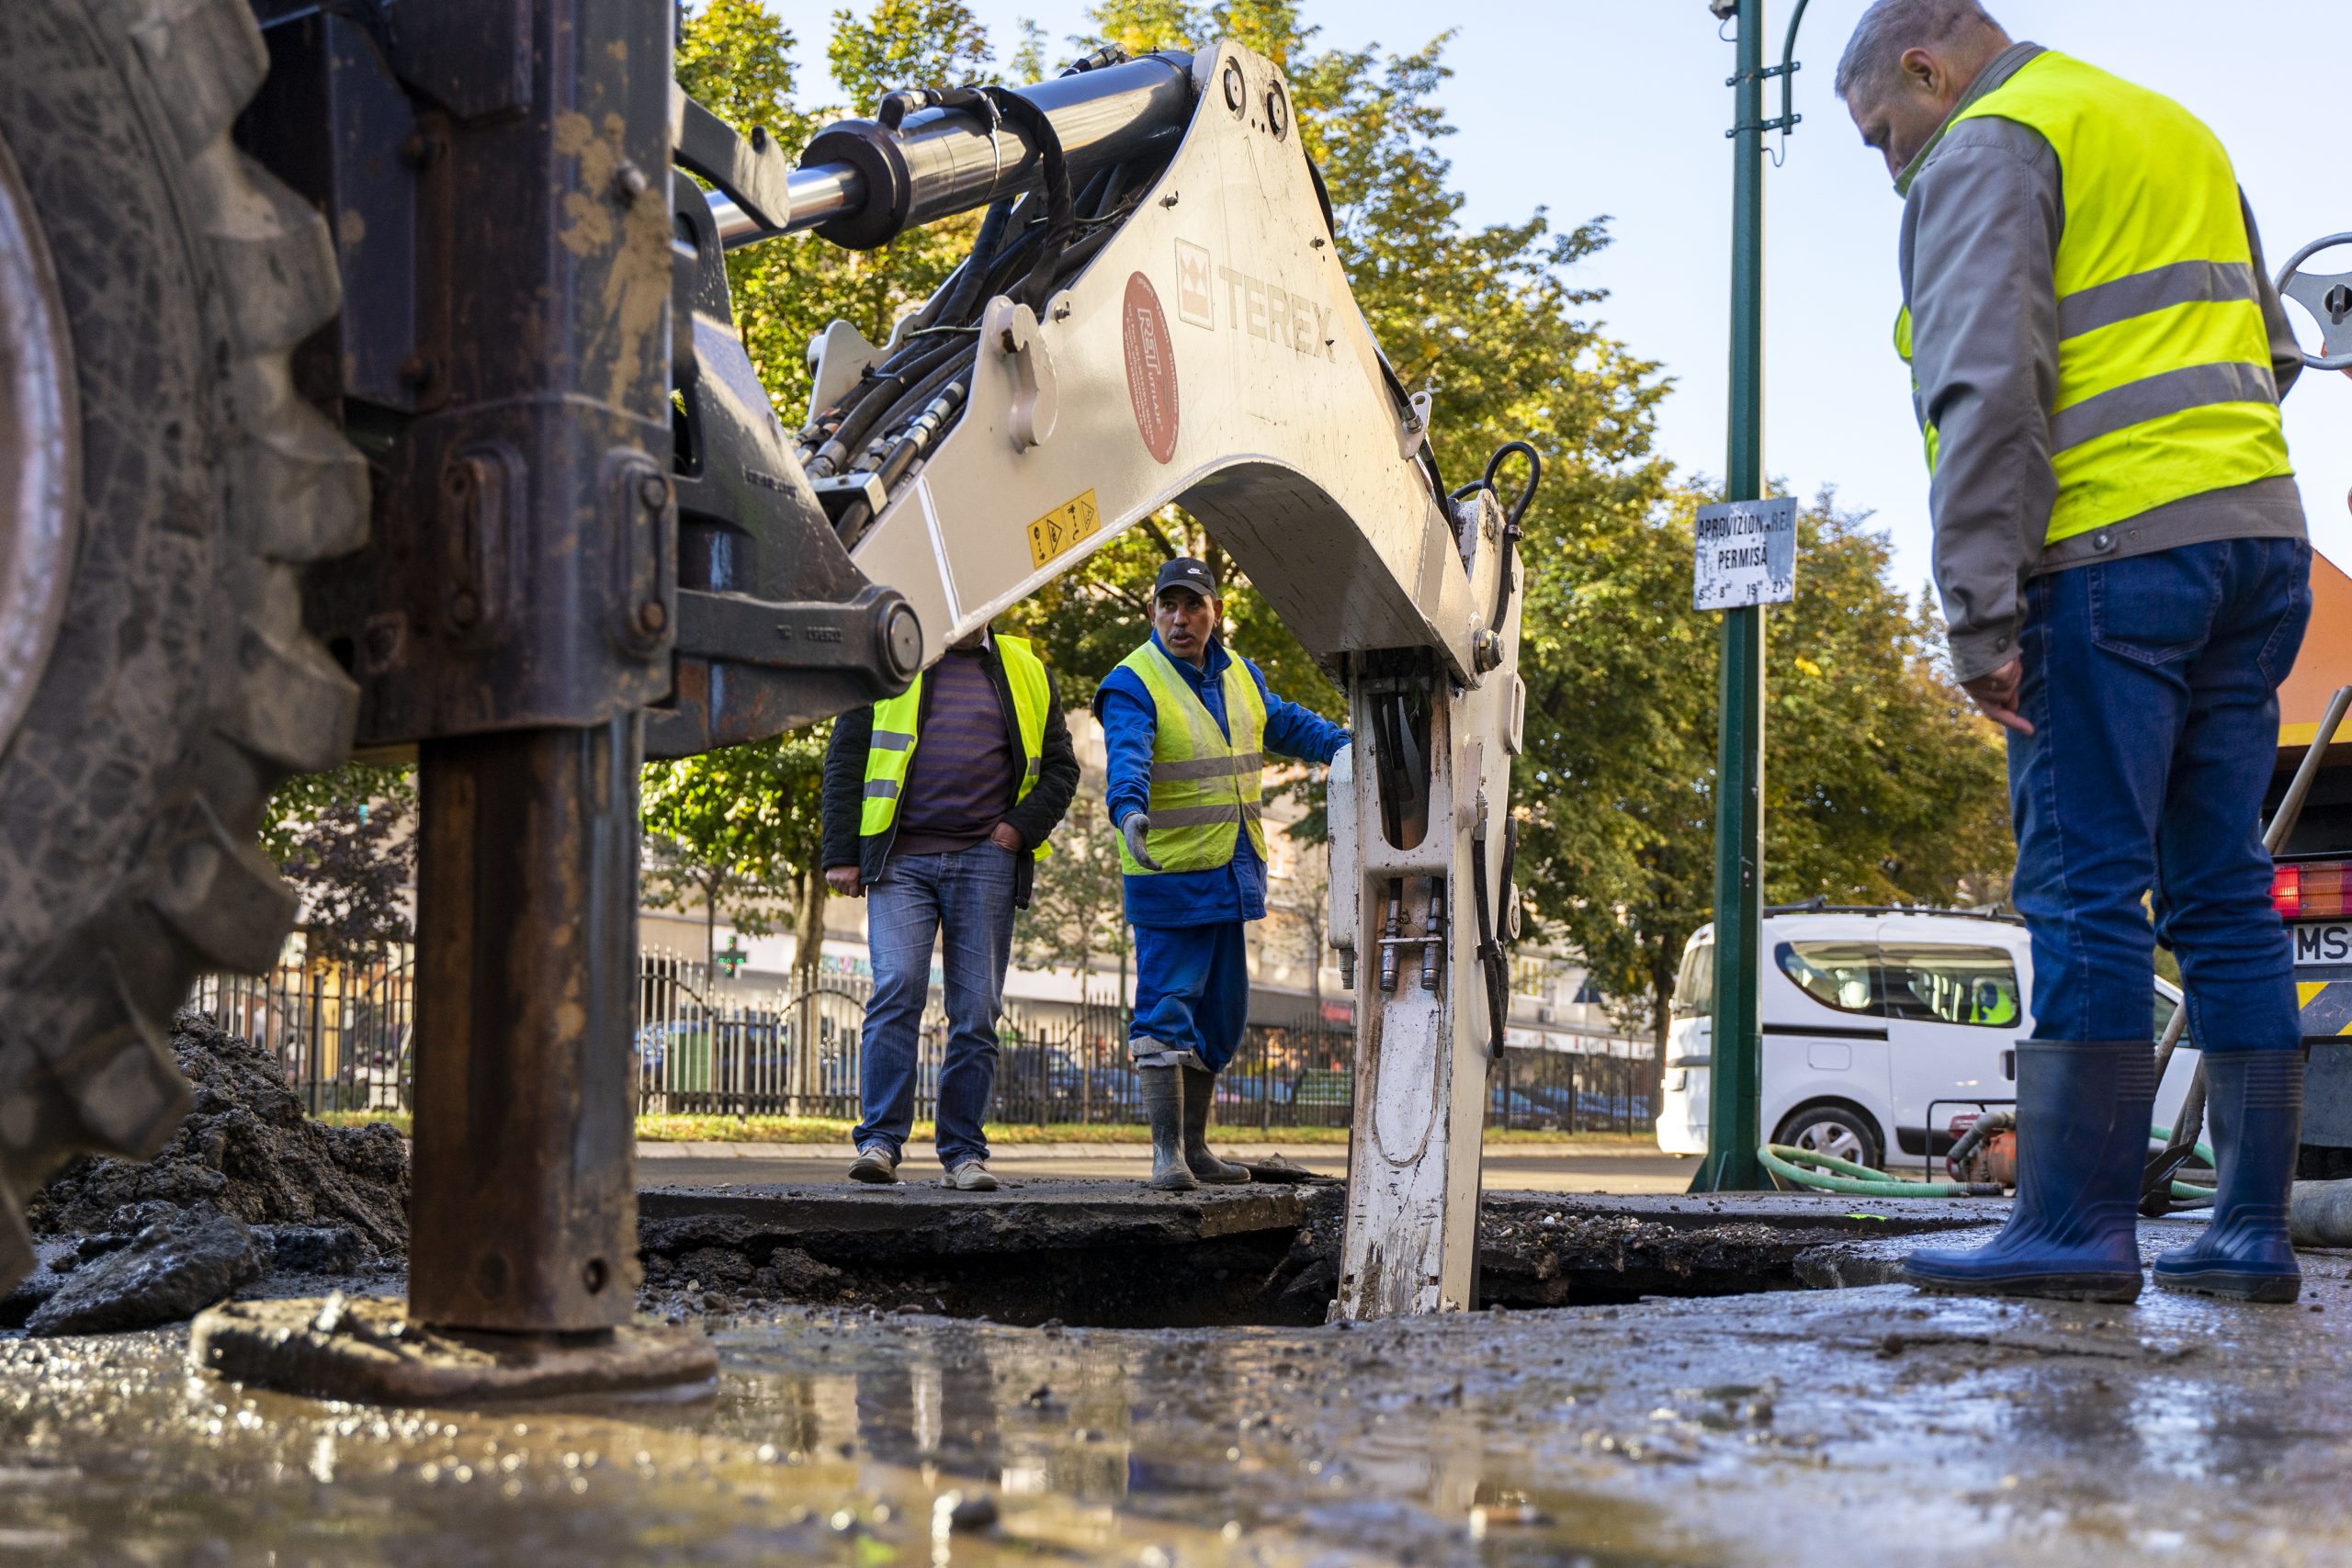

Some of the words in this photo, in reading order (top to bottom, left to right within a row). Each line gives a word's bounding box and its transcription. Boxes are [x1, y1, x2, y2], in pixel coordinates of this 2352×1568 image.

[1137, 309, 1160, 375] RET
[1219, 265, 1335, 363] TEREX
[1148, 372, 1160, 424] UTILAJE
[2298, 927, 2348, 960] MS
